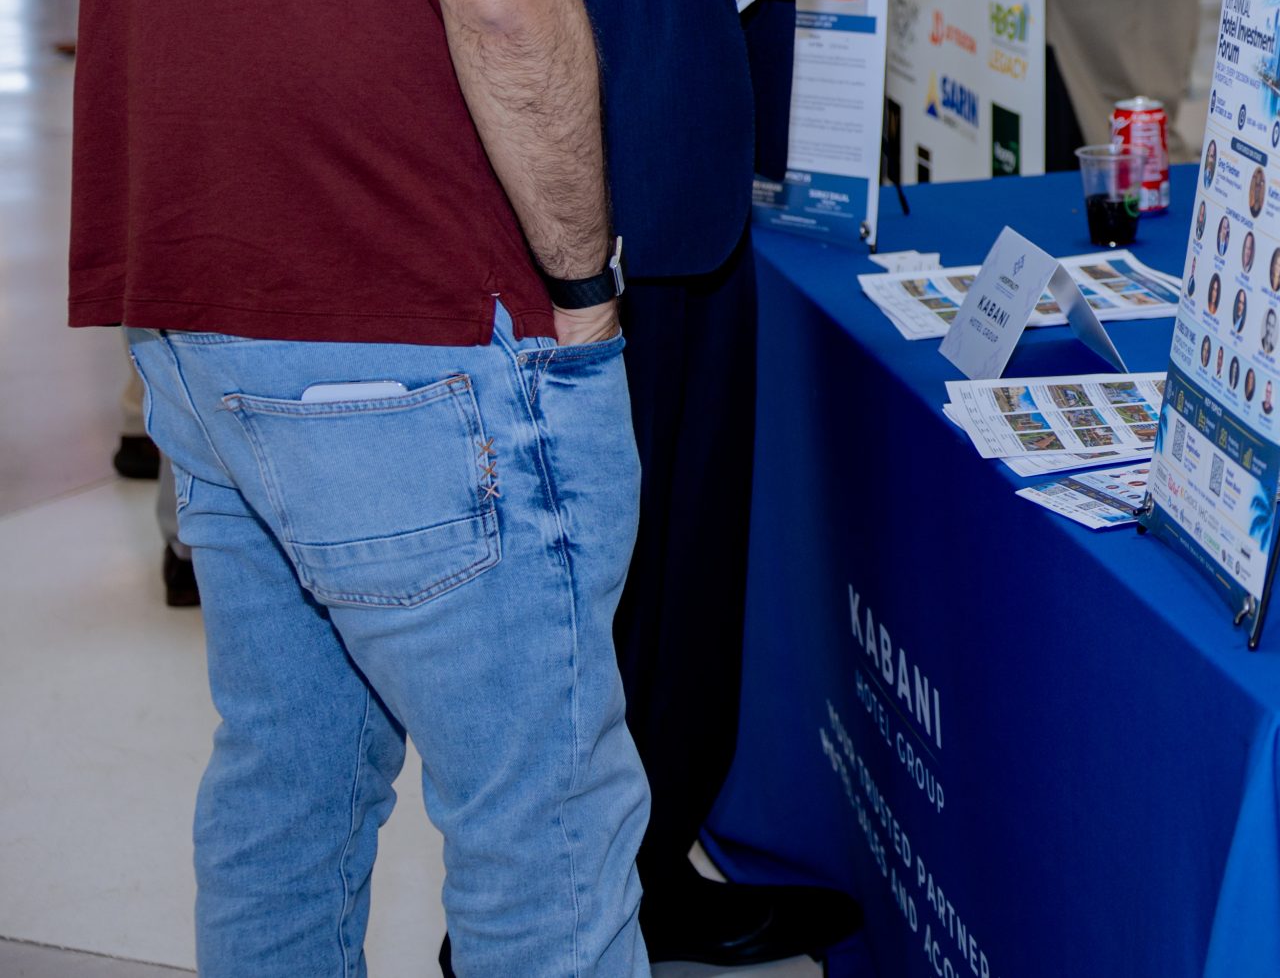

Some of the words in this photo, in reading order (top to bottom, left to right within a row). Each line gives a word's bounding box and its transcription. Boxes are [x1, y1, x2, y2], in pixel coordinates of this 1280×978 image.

[1217, 33, 1241, 65] Forum
[1220, 9, 1239, 40] Hotel
[1236, 15, 1276, 56] Investment
[989, 49, 1029, 82] LEGACY
[941, 75, 980, 129] SARIN
[969, 316, 984, 334] HOTEL
[982, 327, 999, 343] GROUP
[977, 294, 1010, 329] KABANI
[849, 583, 942, 750] KABANI
[855, 668, 892, 747] HOTEL
[896, 731, 945, 814] GROUP
[856, 754, 912, 869] TRUSTED
[916, 854, 990, 978] PARTNER
[891, 867, 918, 933] AND
